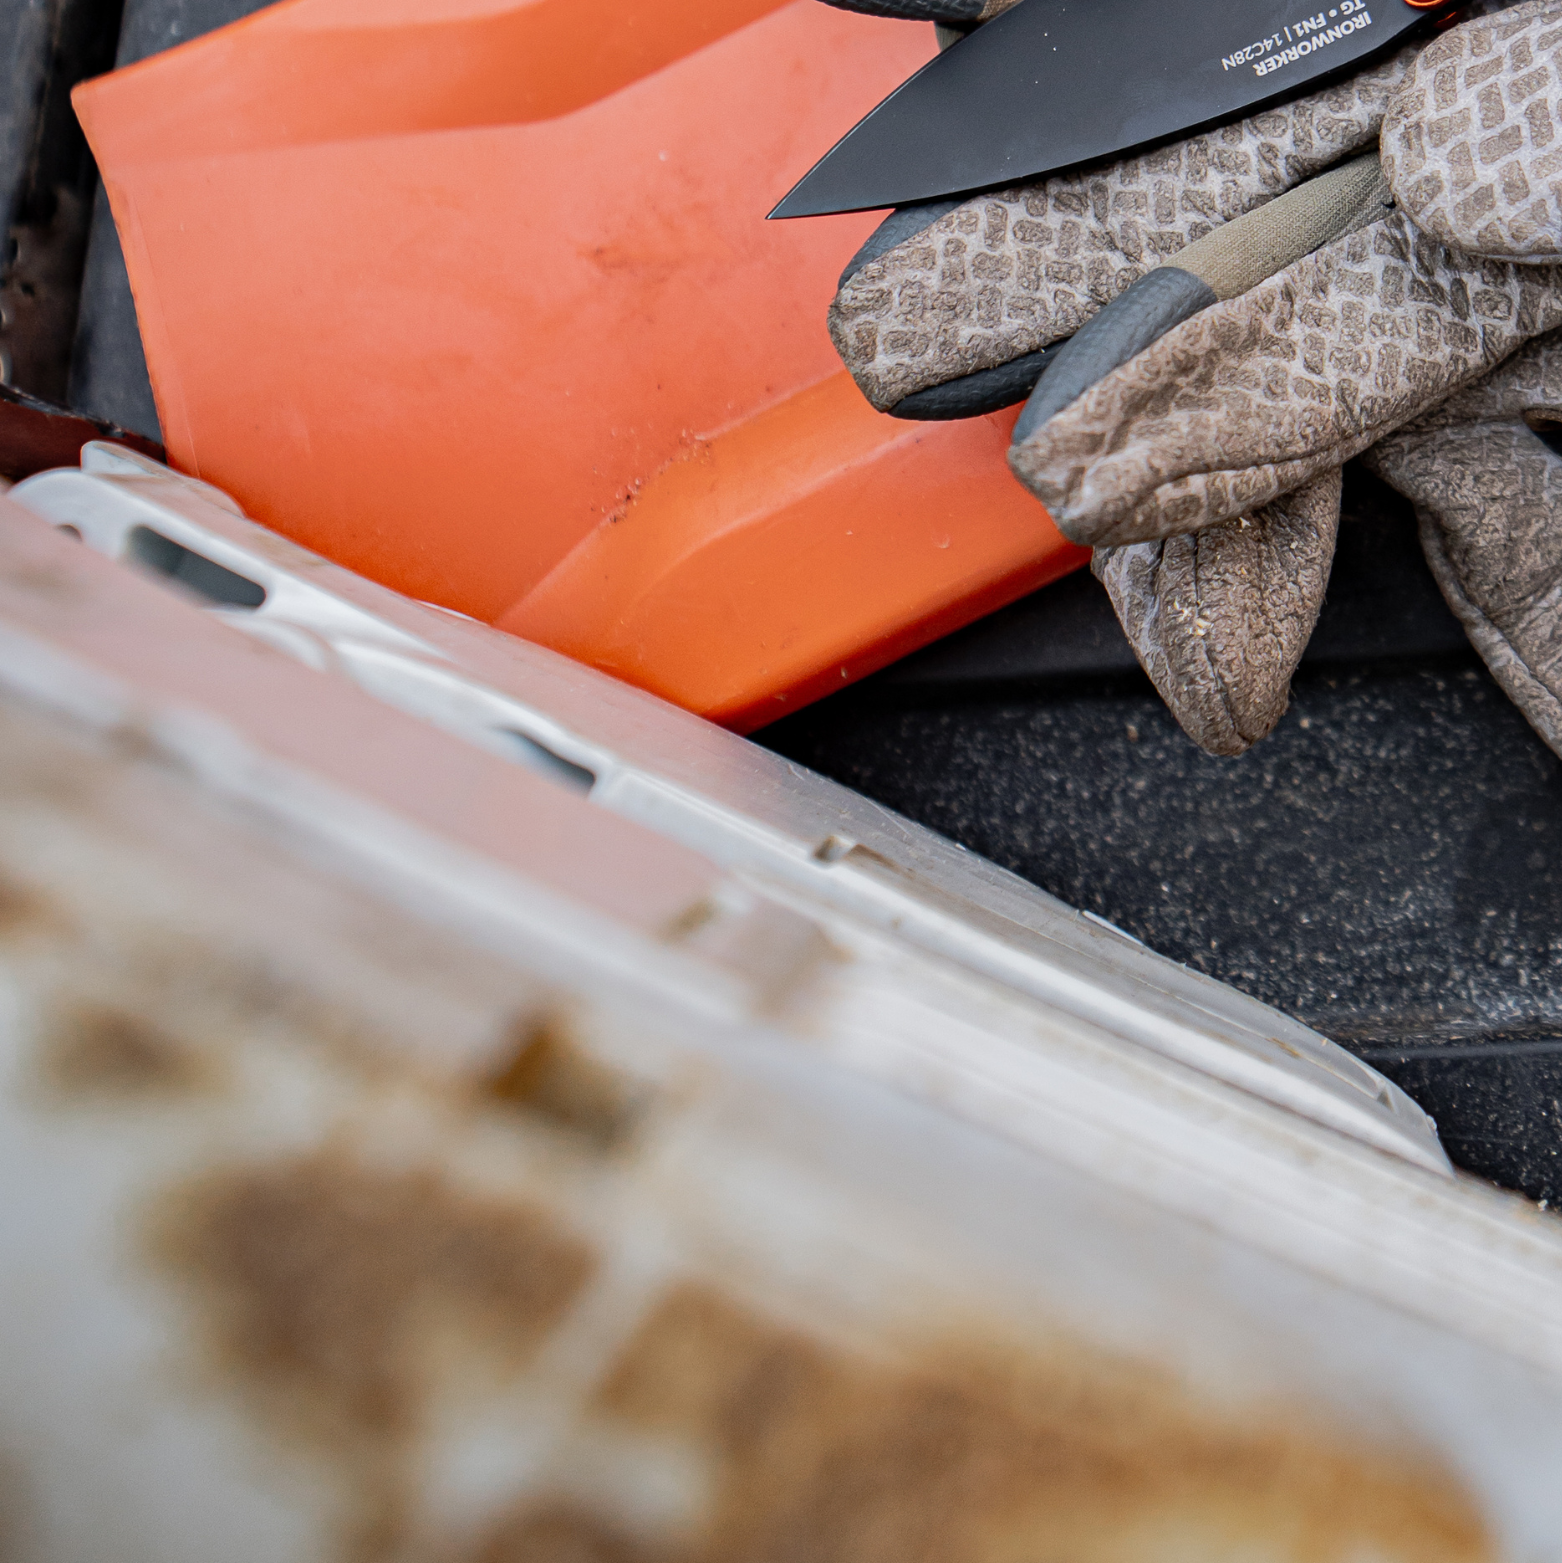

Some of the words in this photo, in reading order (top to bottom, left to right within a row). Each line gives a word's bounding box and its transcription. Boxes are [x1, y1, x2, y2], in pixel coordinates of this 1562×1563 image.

[1252, 10, 1373, 78] IRONWORKER
[1292, 12, 1327, 37] FN1
[1221, 32, 1284, 72] 14C28N
